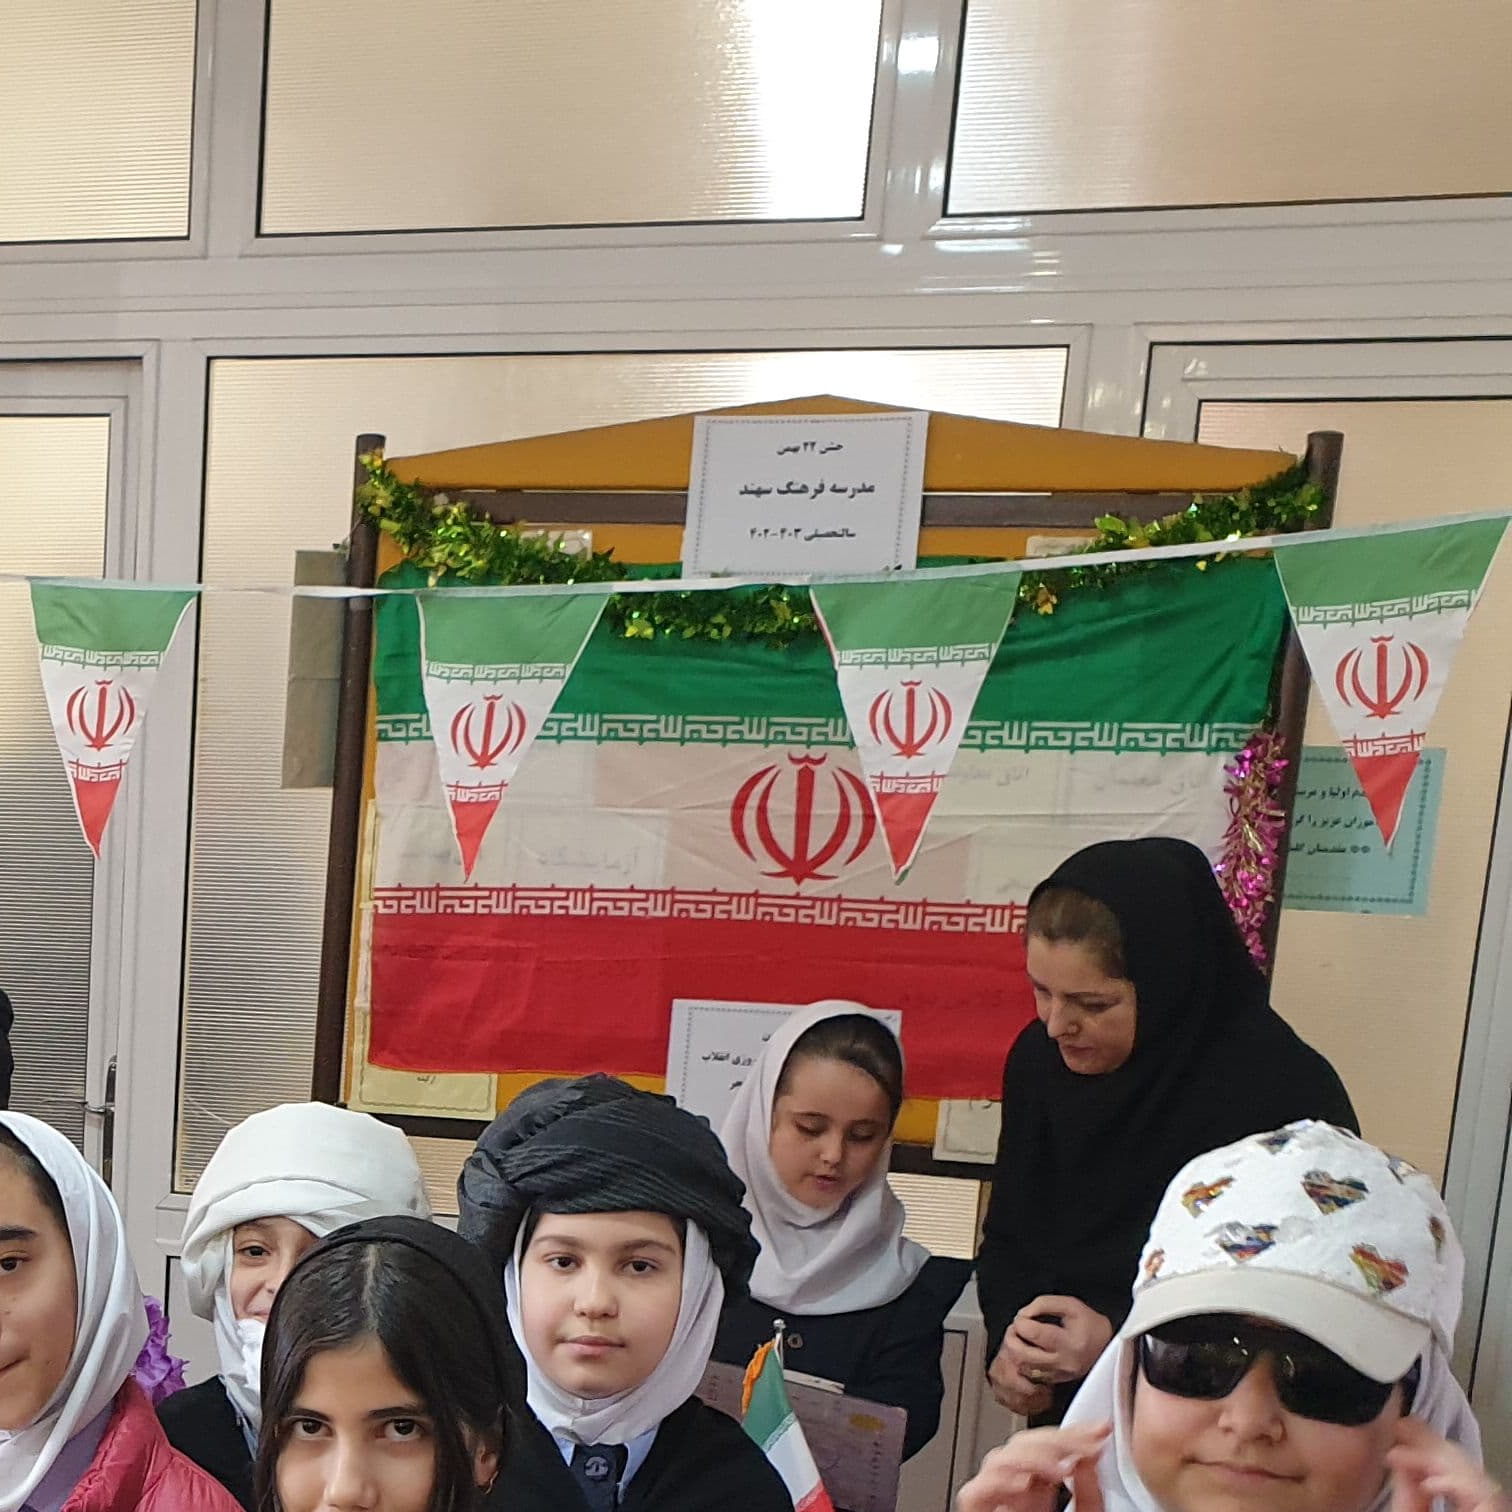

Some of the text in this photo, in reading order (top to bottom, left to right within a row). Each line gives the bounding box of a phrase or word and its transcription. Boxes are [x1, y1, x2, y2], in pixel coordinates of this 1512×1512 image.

[738, 479, 876, 500] مدرسه فرهنگ سهند
[701, 1051, 730, 1061] انقلاب
